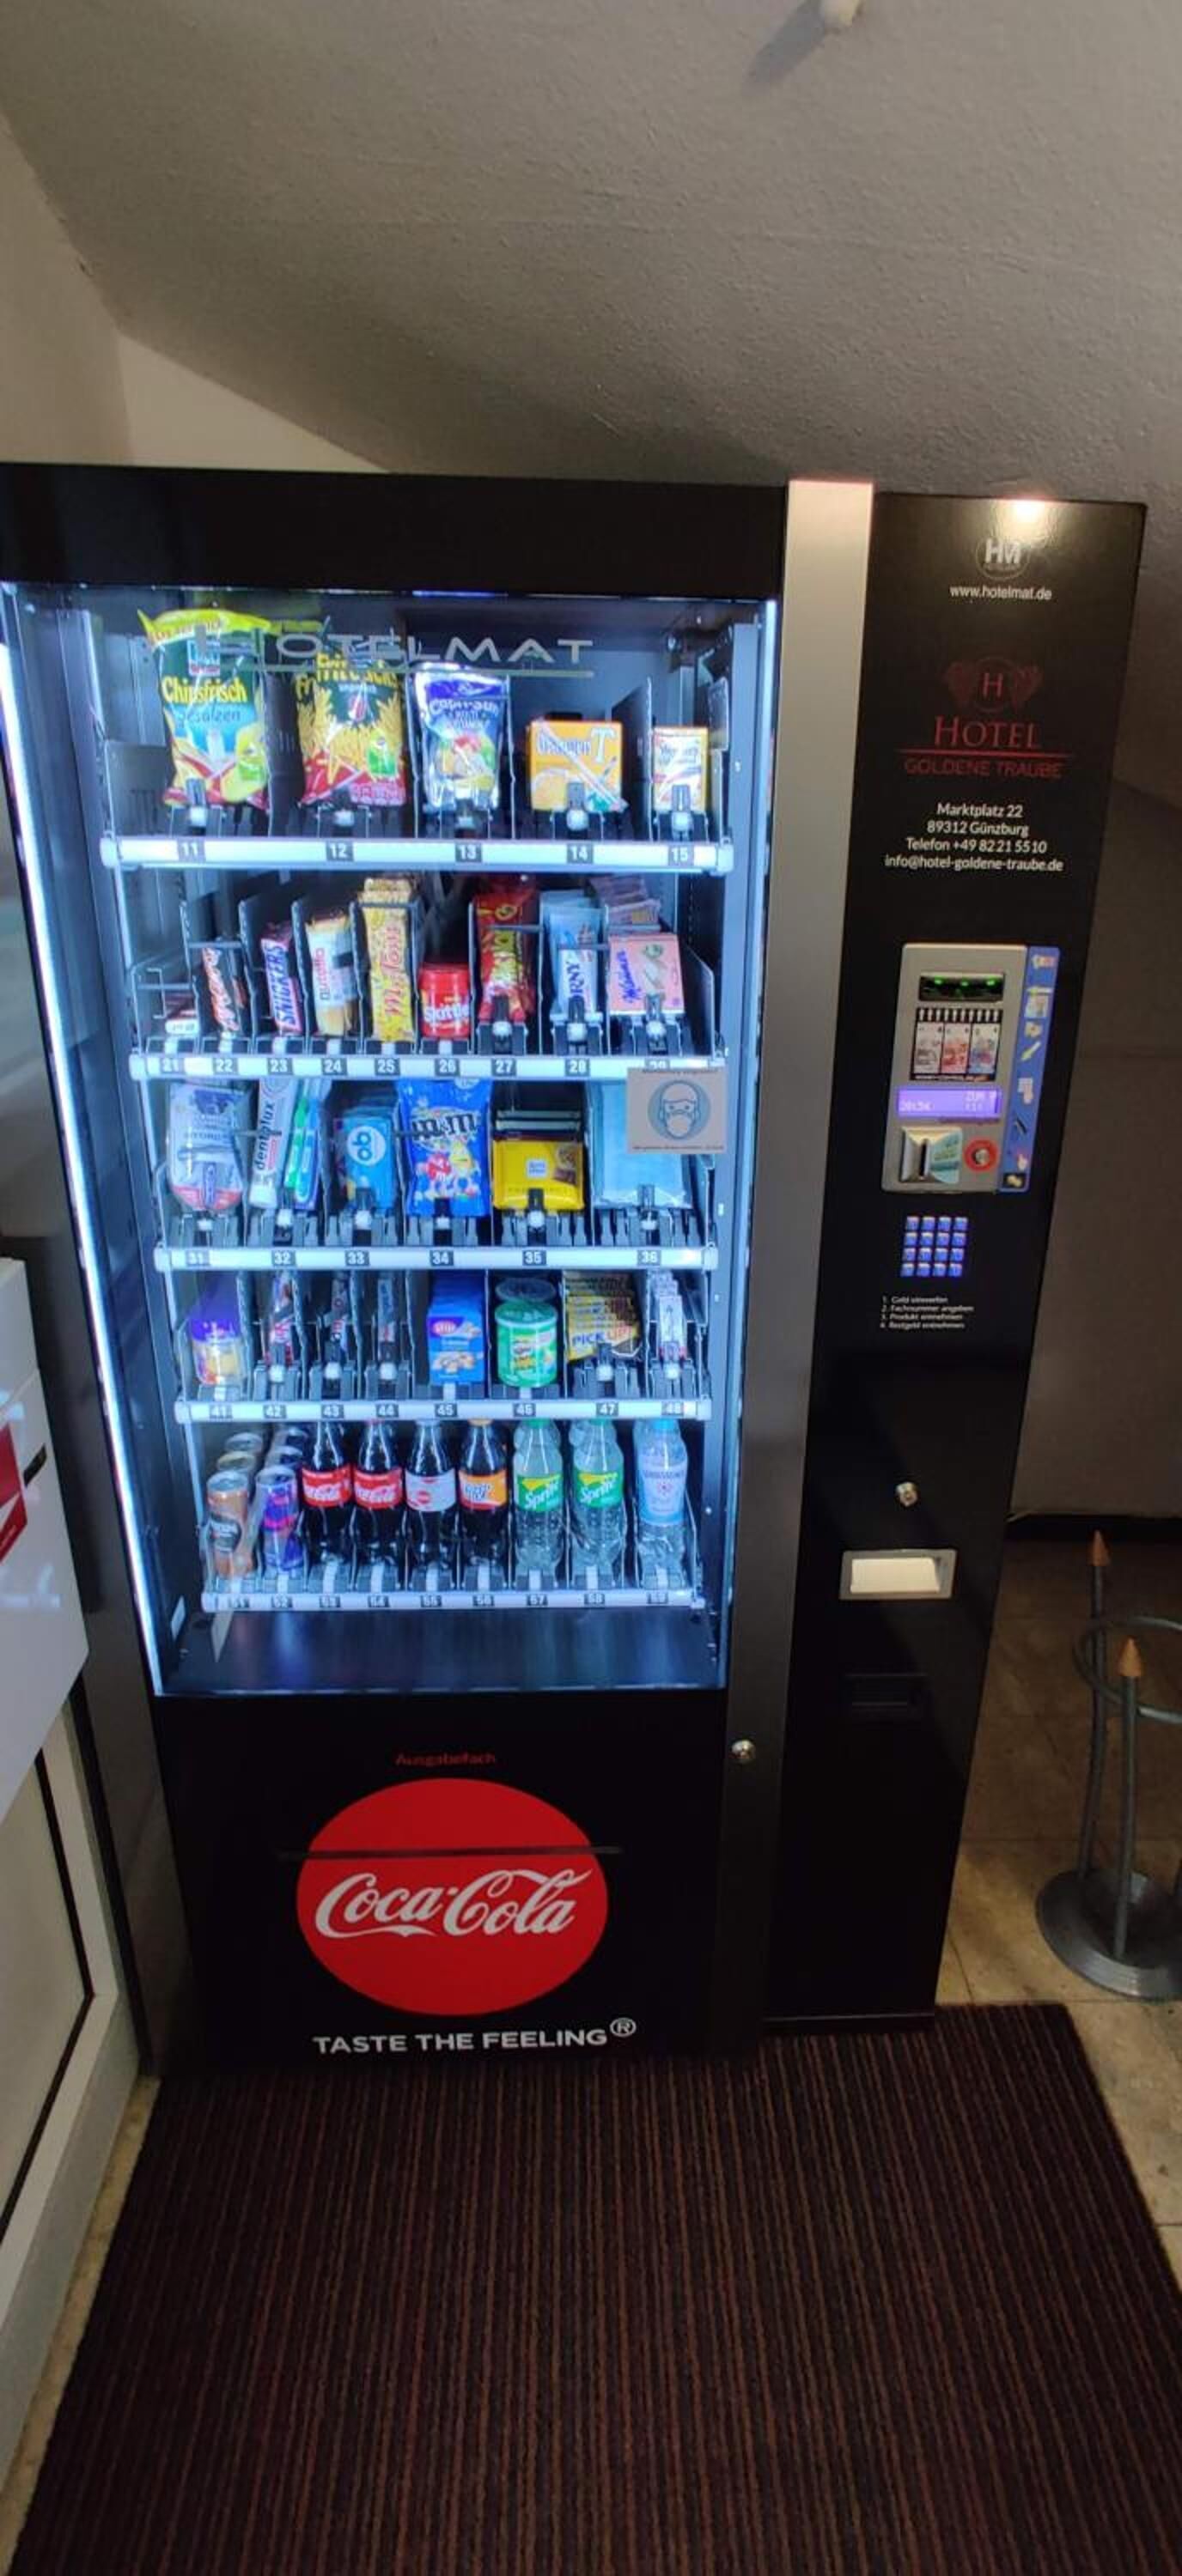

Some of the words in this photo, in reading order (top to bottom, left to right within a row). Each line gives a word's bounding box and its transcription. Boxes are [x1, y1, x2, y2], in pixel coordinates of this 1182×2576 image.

[950, 585, 1052, 601] www.hotelmat.de
[193, 627, 594, 665] HOTELMAT
[984, 672, 1004, 697] H
[935, 716, 1042, 750] HOTEL
[904, 758, 990, 777] GOLDENE
[997, 761, 1063, 779] TRAUBE
[937, 803, 1005, 820] Marktplatz
[1007, 805, 1023, 818] 22
[927, 821, 967, 835] 89312
[969, 821, 1030, 839] Günzburg
[181, 841, 198, 856] 11
[330, 843, 348, 858] 12
[459, 846, 477, 860] 13
[570, 846, 590, 861] 14
[673, 847, 689, 862] 15
[906, 837, 950, 851] Telefon
[954, 839, 976, 853] +49
[885, 854, 1064, 872] info@hotel-goldene-traube.de
[265, 945, 296, 1026] SNICKERS
[162, 1059, 179, 1072] 21
[216, 1060, 233, 1072] 22
[271, 1060, 288, 1072] 23
[325, 1060, 342, 1072] 24
[378, 1060, 395, 1072] 25
[439, 1060, 457, 1073] 26
[496, 1060, 513, 1073] 27
[569, 1060, 587, 1073] 28
[257, 1100, 274, 1171] dentalux
[189, 1252, 203, 1265] 31
[275, 1253, 291, 1265] 32
[349, 1253, 364, 1265] 33
[432, 1251, 448, 1265] 34
[524, 1251, 542, 1265] 35
[265, 1406, 281, 1417] 42
[324, 1406, 339, 1417] 43
[378, 1405, 393, 1417] 44
[437, 1404, 454, 1416] 45
[515, 1404, 533, 1416] 46
[599, 1404, 616, 1416] 47
[579, 1478, 619, 1502] Sprite
[395, 1753, 497, 1767] Ausgabefach
[315, 1868, 594, 1939] Coca-Cola
[313, 2035, 407, 2055] TASTE
[415, 2032, 474, 2050] THE
